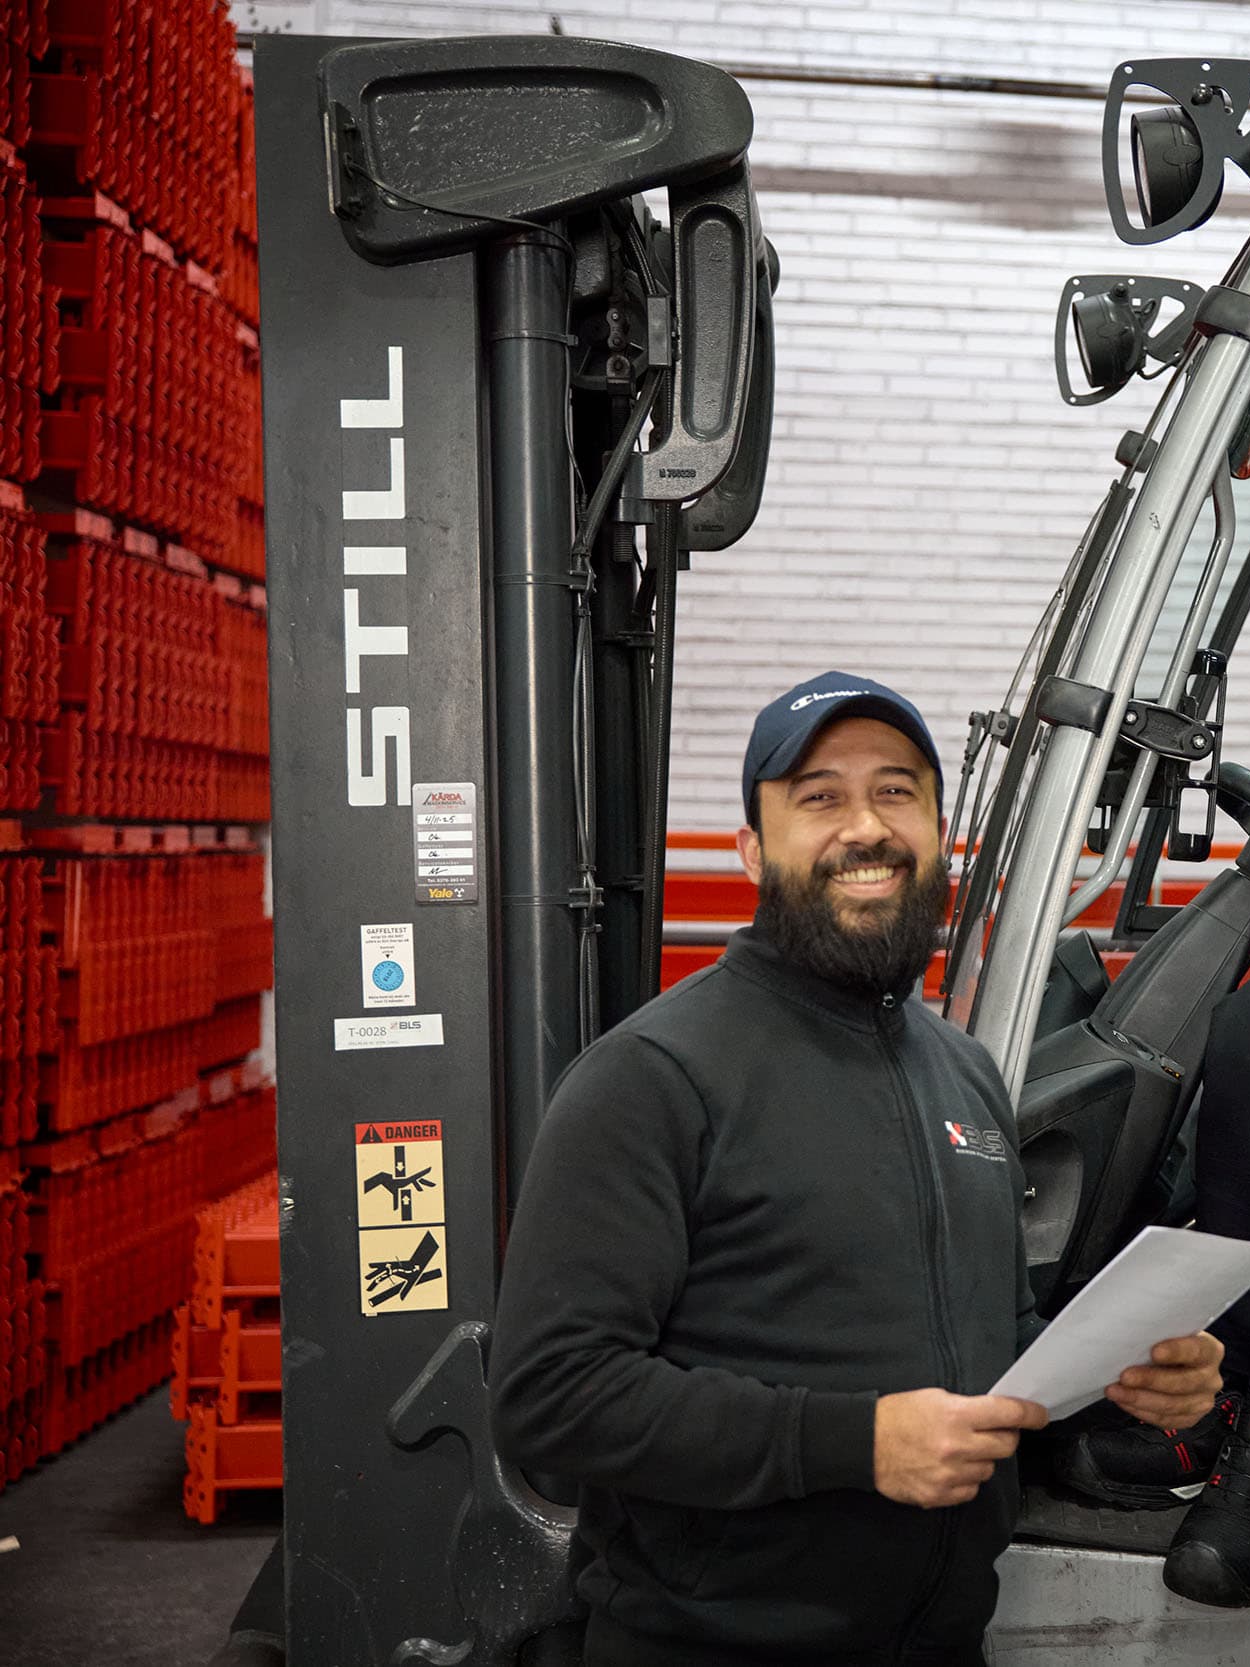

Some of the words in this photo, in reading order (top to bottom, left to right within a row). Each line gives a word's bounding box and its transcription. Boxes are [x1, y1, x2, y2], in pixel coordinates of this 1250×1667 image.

[340, 346, 412, 806] STILL
[429, 888, 454, 898] Yale
[347, 1026, 387, 1037] T-0028
[399, 1021, 422, 1030] BLS
[385, 1124, 438, 1139] DANGER
